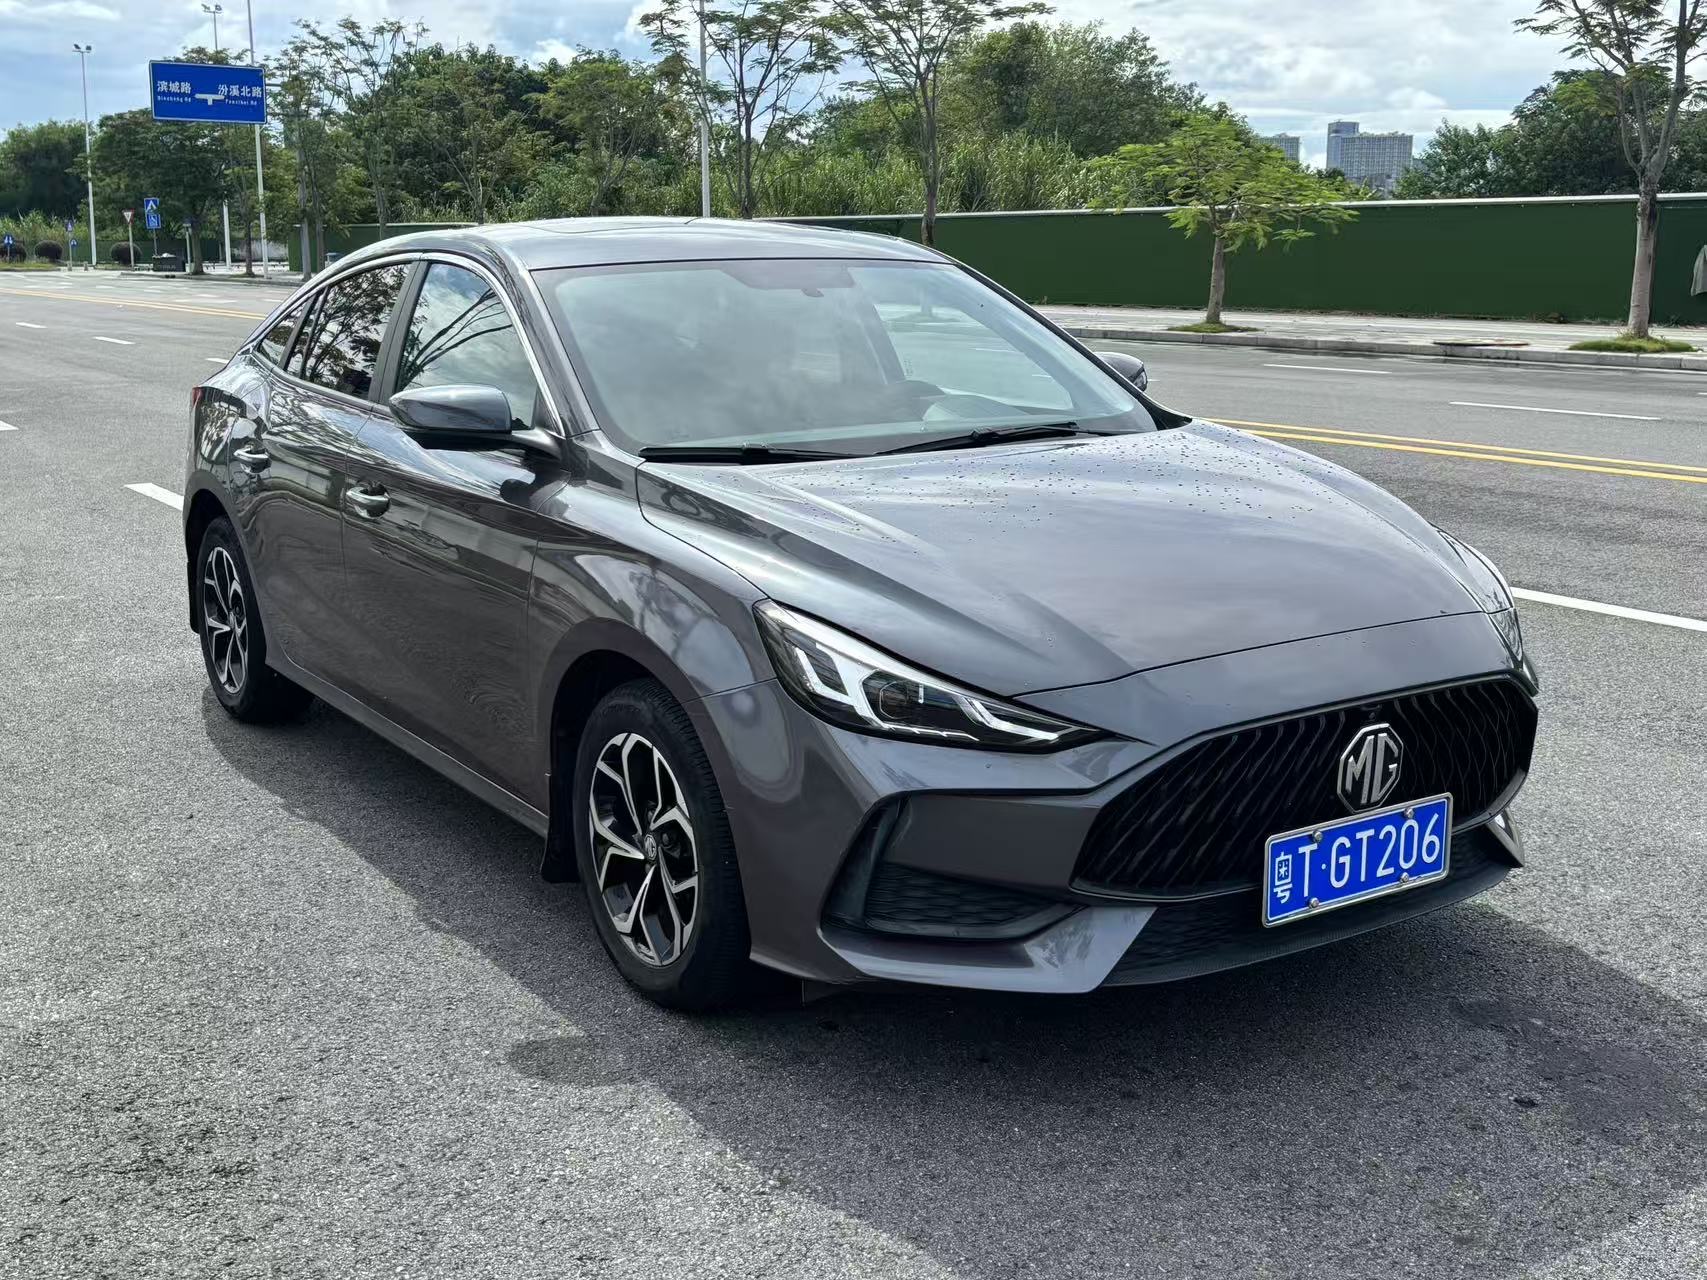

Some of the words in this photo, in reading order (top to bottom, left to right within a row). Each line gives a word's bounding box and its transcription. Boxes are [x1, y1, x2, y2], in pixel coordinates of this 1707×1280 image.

[157, 80, 191, 94] 滨城路
[218, 84, 262, 98] 汾溪北路
[1345, 733, 1399, 804] MG
